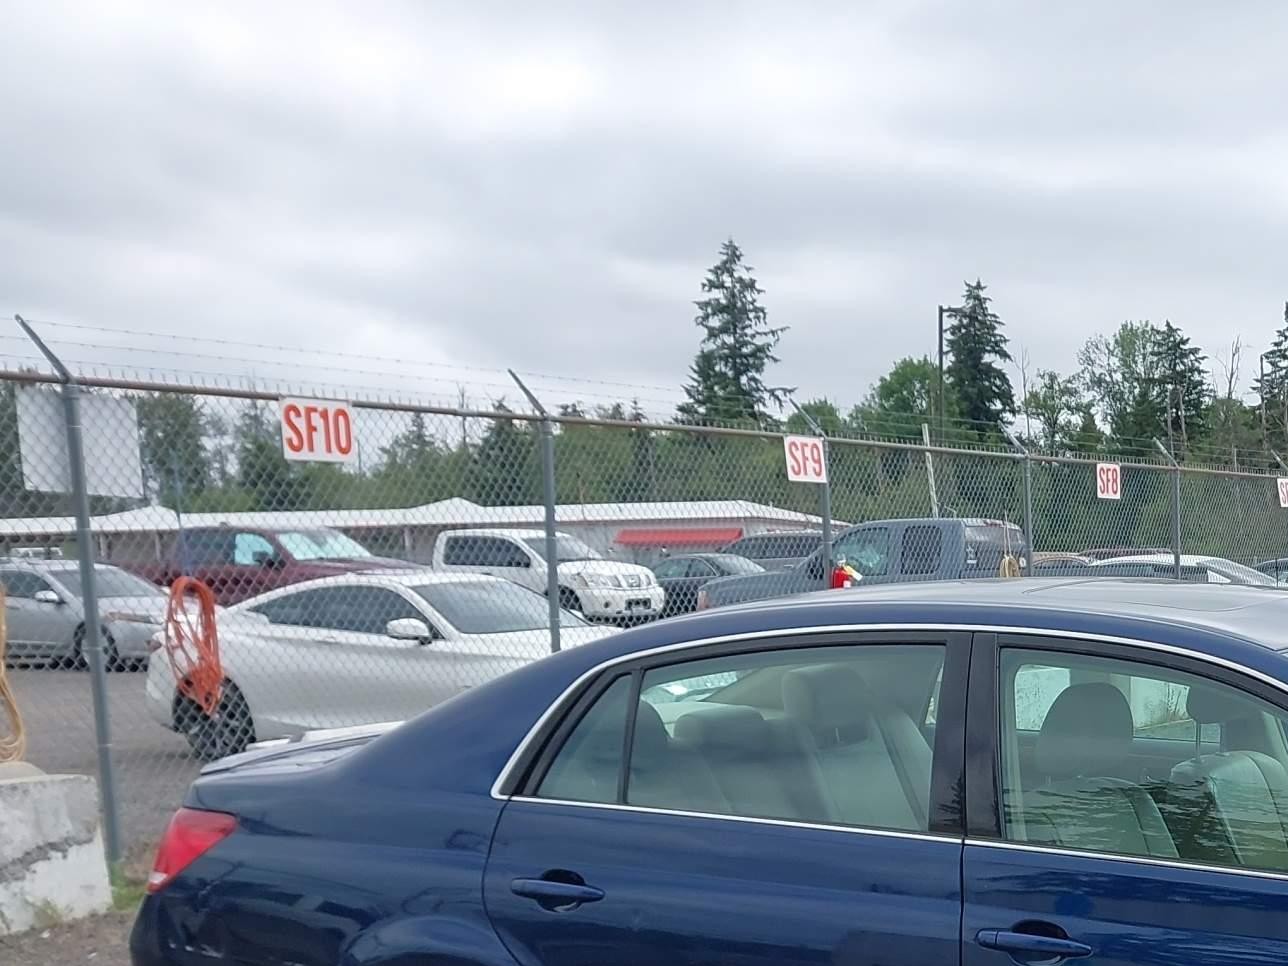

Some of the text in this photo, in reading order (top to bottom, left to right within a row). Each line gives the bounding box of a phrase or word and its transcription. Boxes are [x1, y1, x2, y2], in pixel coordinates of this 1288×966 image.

[284, 404, 352, 455] SF10
[788, 441, 822, 477] SF9
[1099, 466, 1118, 495] SF8
